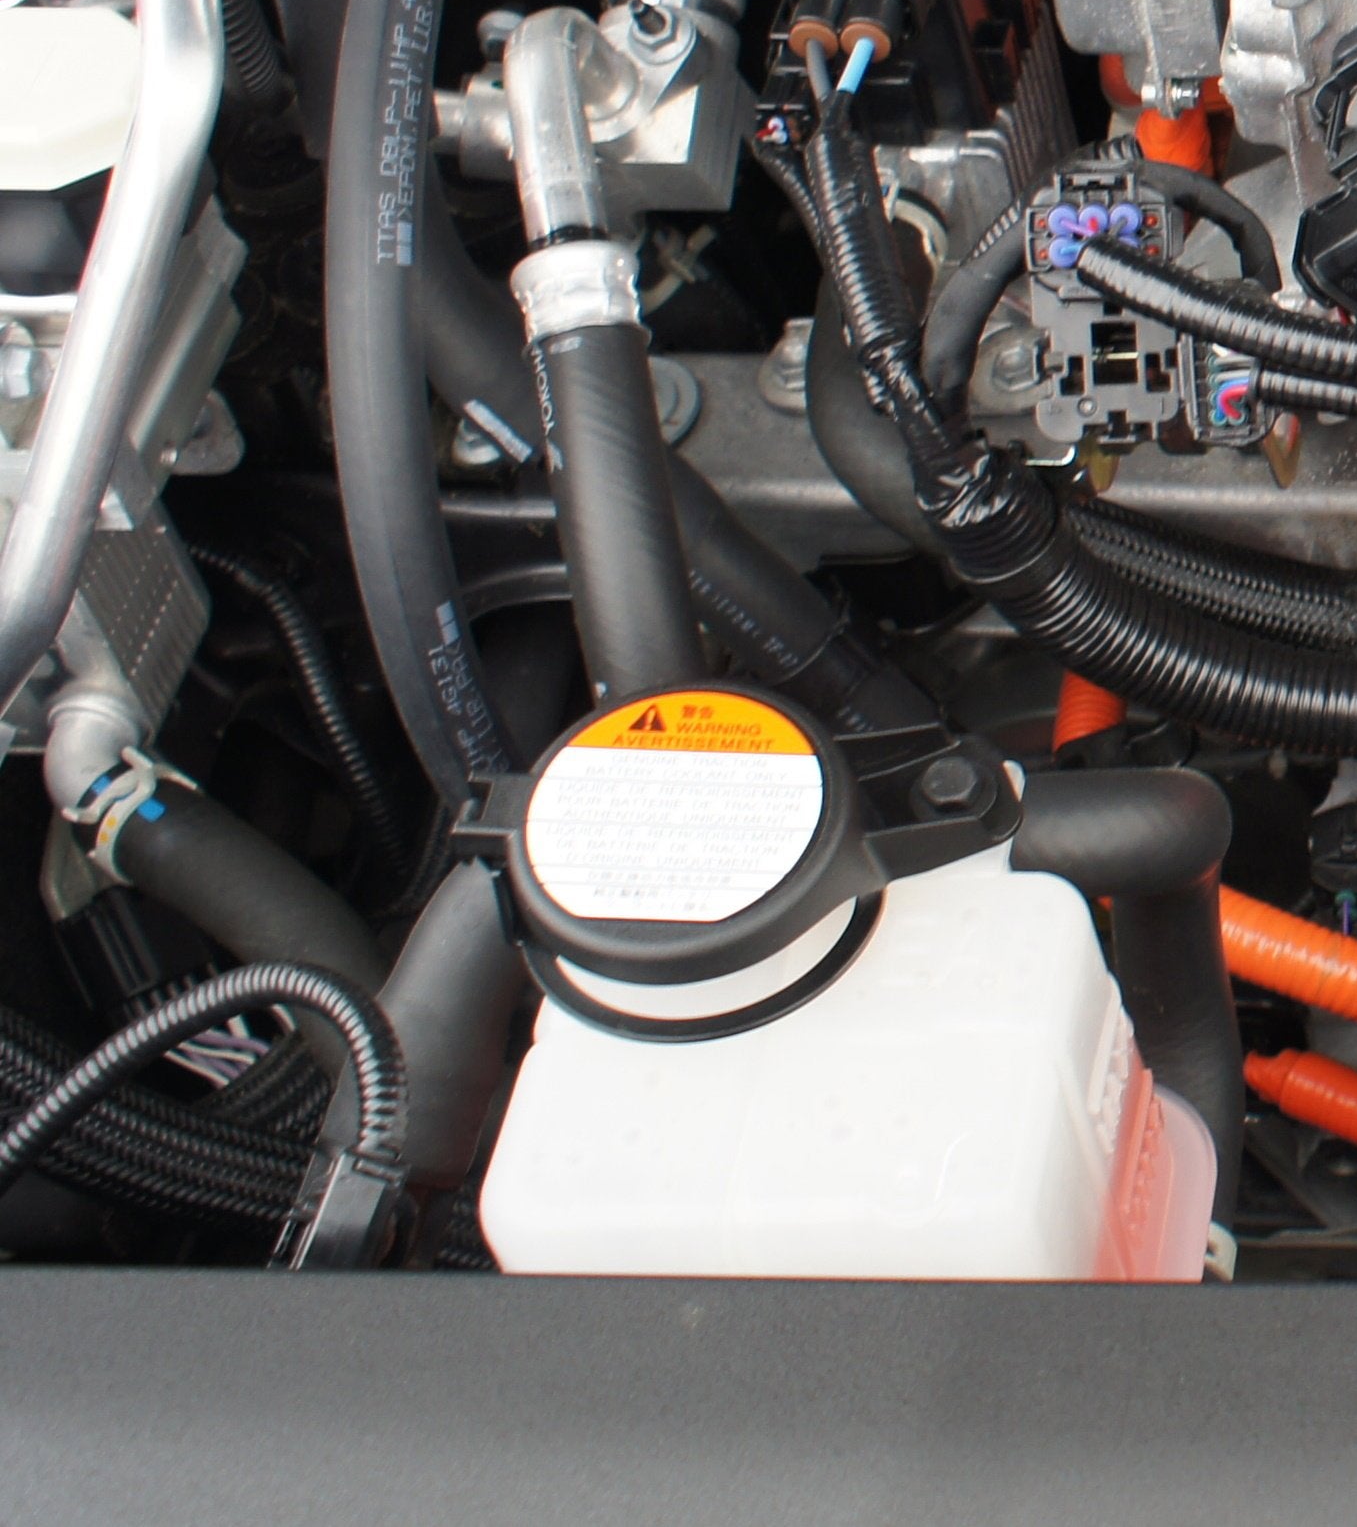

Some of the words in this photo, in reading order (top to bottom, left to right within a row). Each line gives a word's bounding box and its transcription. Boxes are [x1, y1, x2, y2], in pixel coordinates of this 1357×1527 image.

[676, 720, 762, 736] WARNING
[613, 734, 776, 751] AVERTISSEMENT
[585, 766, 654, 778] BATTERY
[662, 768, 736, 780] COOLANT
